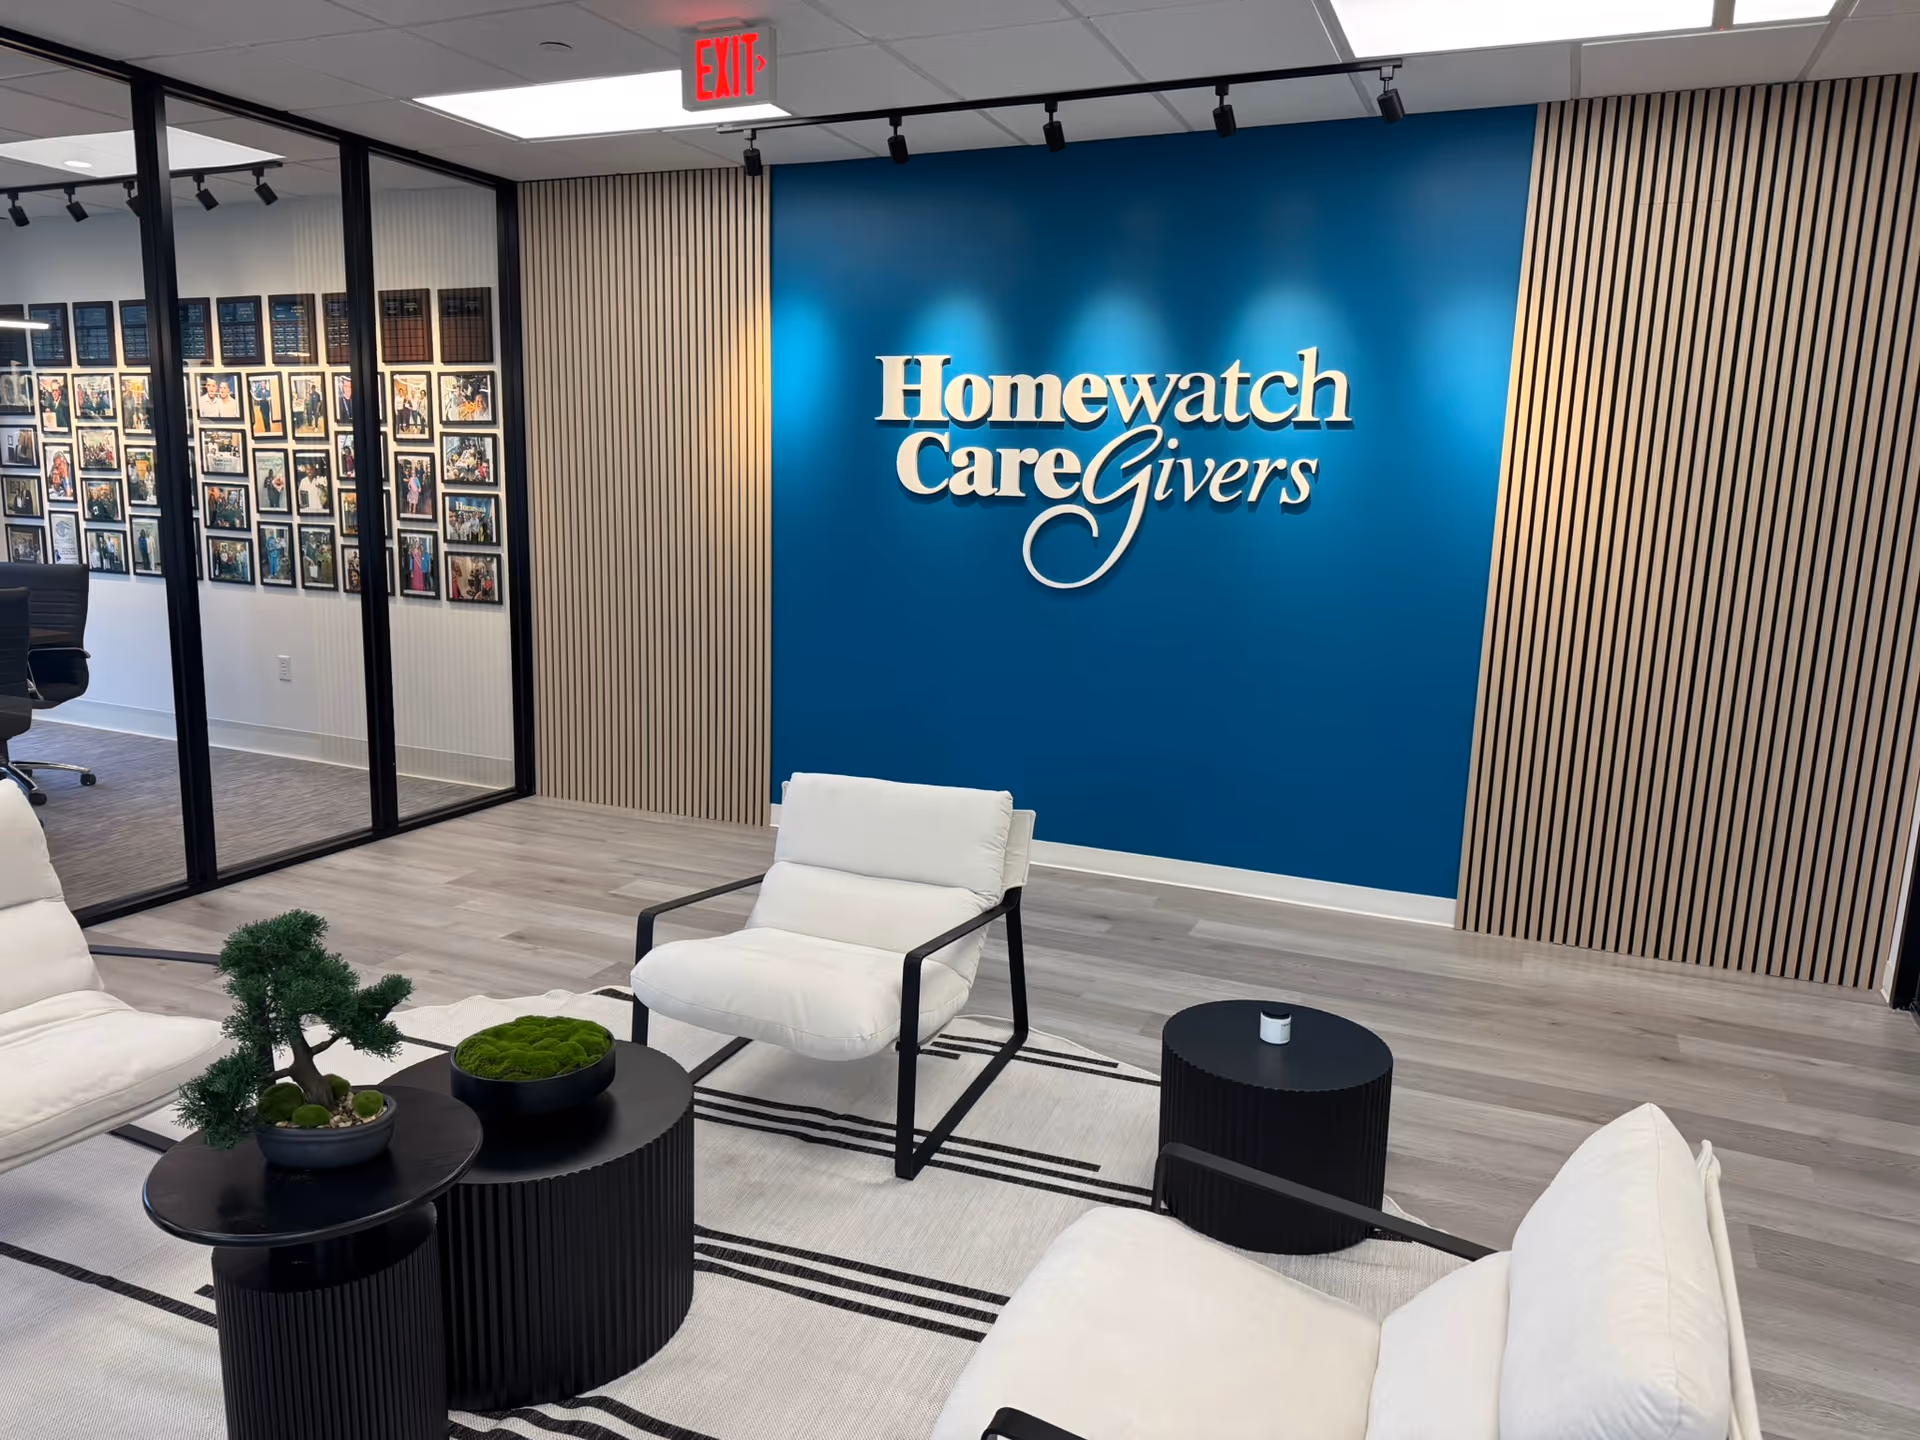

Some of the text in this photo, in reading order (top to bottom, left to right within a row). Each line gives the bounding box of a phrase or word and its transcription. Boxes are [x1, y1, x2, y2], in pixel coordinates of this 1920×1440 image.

[695, 33, 758, 101] EXIT
[875, 347, 1352, 424] Homewatch
[896, 425, 1318, 589] CareGivers
